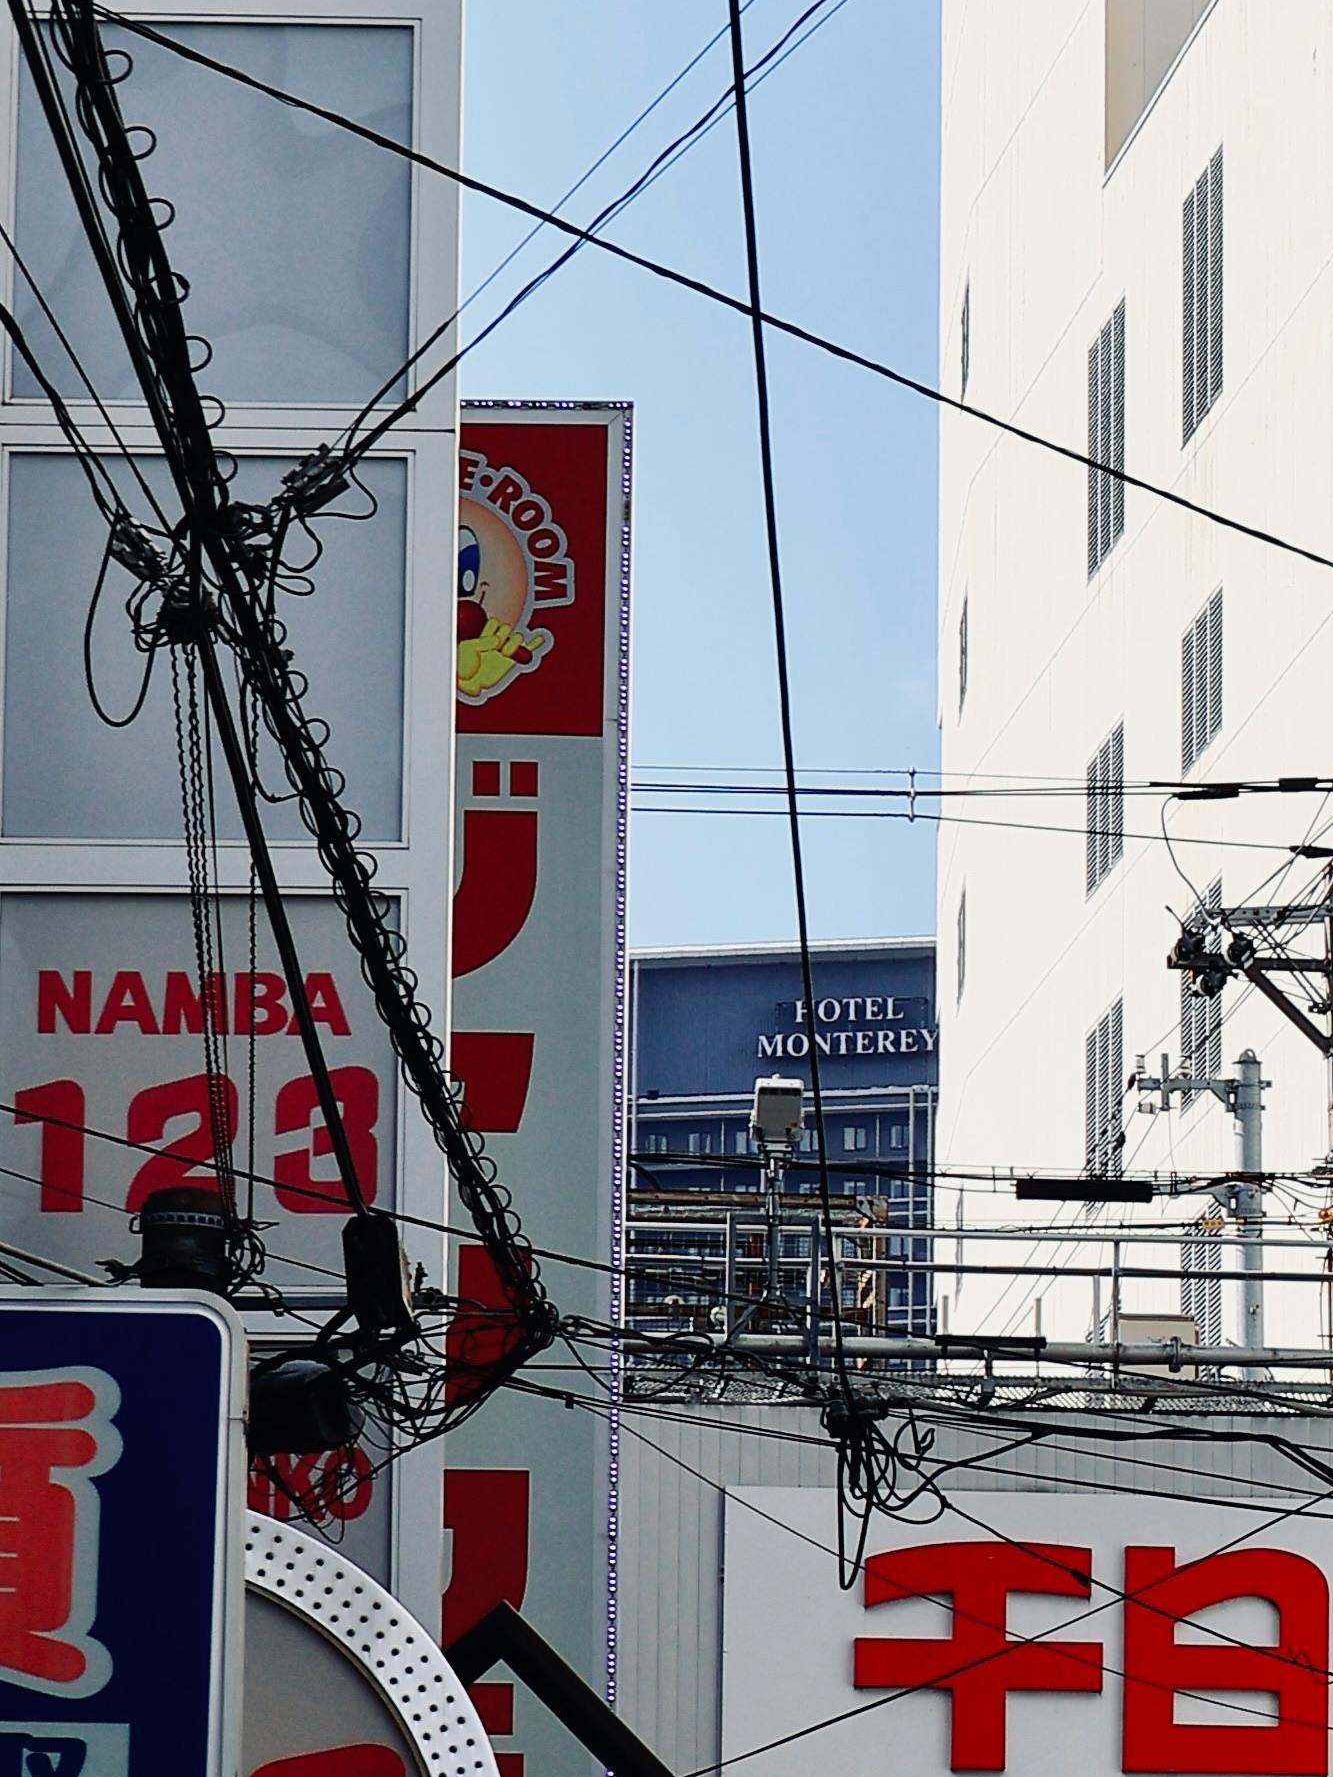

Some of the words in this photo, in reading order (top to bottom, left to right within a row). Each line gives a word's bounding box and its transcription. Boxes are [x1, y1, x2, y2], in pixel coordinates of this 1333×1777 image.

[38, 969, 352, 1036] NAMBA
[795, 996, 904, 1022] HOTEL
[757, 1027, 939, 1059] MONTEREY
[14, 1065, 380, 1215] 123
